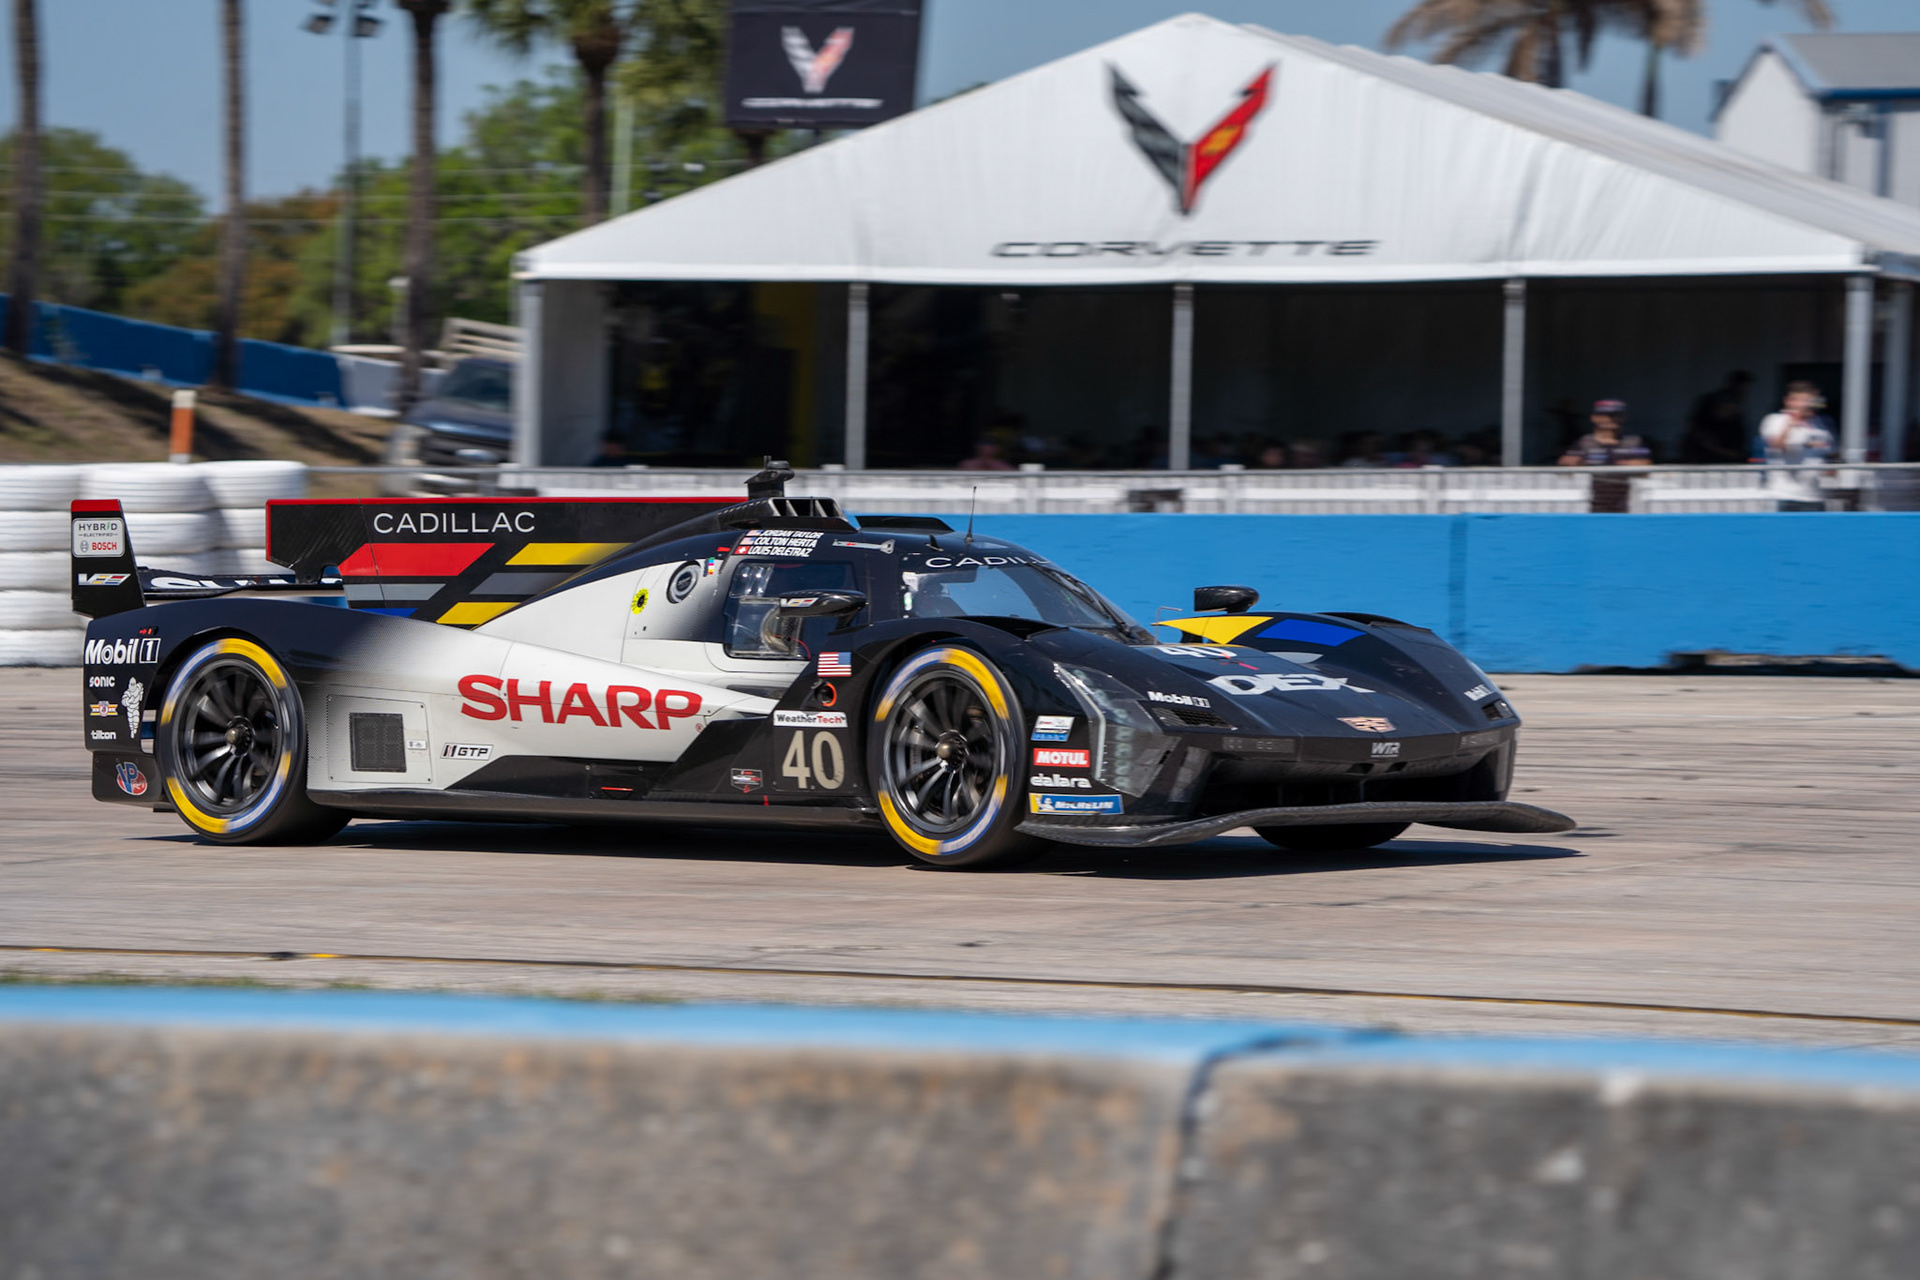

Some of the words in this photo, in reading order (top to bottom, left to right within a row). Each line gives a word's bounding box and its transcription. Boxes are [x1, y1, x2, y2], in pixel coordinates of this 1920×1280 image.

[989, 240, 1379, 257] CORVETTE
[78, 522, 118, 531] HYBRID
[373, 511, 536, 534] CADILLAC
[792, 531, 824, 539] TAYLOR
[91, 542, 117, 551] BOSCH
[754, 537, 789, 546] COLTON
[787, 539, 818, 548] HERTA
[748, 546, 773, 555] LOUIS
[770, 547, 813, 557] DELETRAZ
[85, 638, 140, 664] Mobil
[458, 674, 703, 731] SHARP
[1146, 691, 1194, 705] Mobil
[776, 714, 842, 724] WeatherTech
[458, 747, 488, 757] GTP
[1371, 742, 1401, 754] WTR
[782, 730, 845, 789] 40
[1036, 751, 1088, 765] MOTUL
[1030, 773, 1092, 788] dallara
[1054, 801, 1114, 809] MICHELIN
